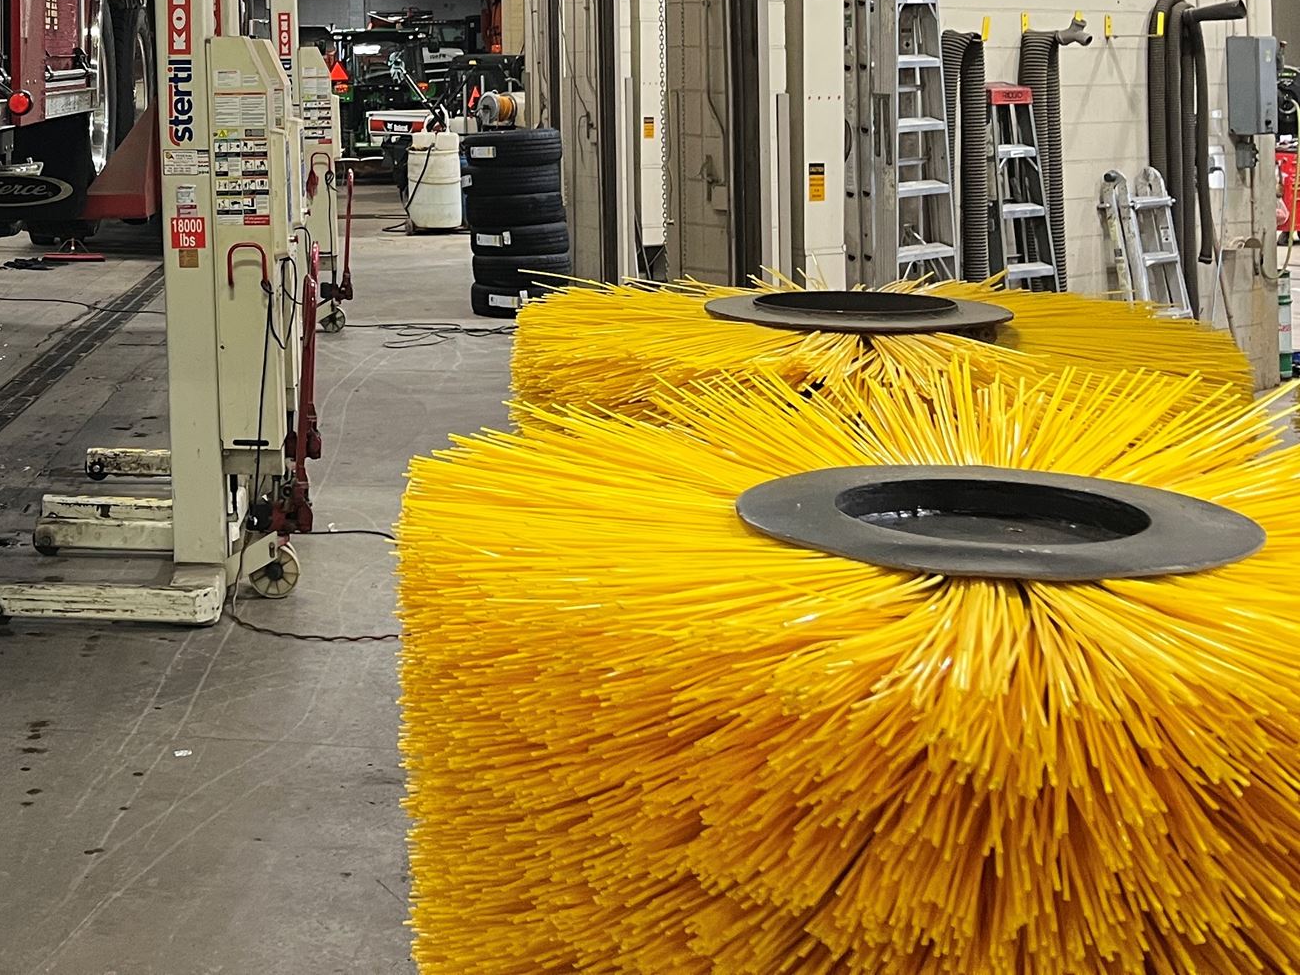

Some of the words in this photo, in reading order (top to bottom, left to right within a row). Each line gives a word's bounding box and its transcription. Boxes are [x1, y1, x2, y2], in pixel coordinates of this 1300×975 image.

[280, 14, 289, 54] KONI
[167, 59, 194, 147] stertil
[172, 218, 203, 233] 18000
[179, 233, 196, 247] lbs
